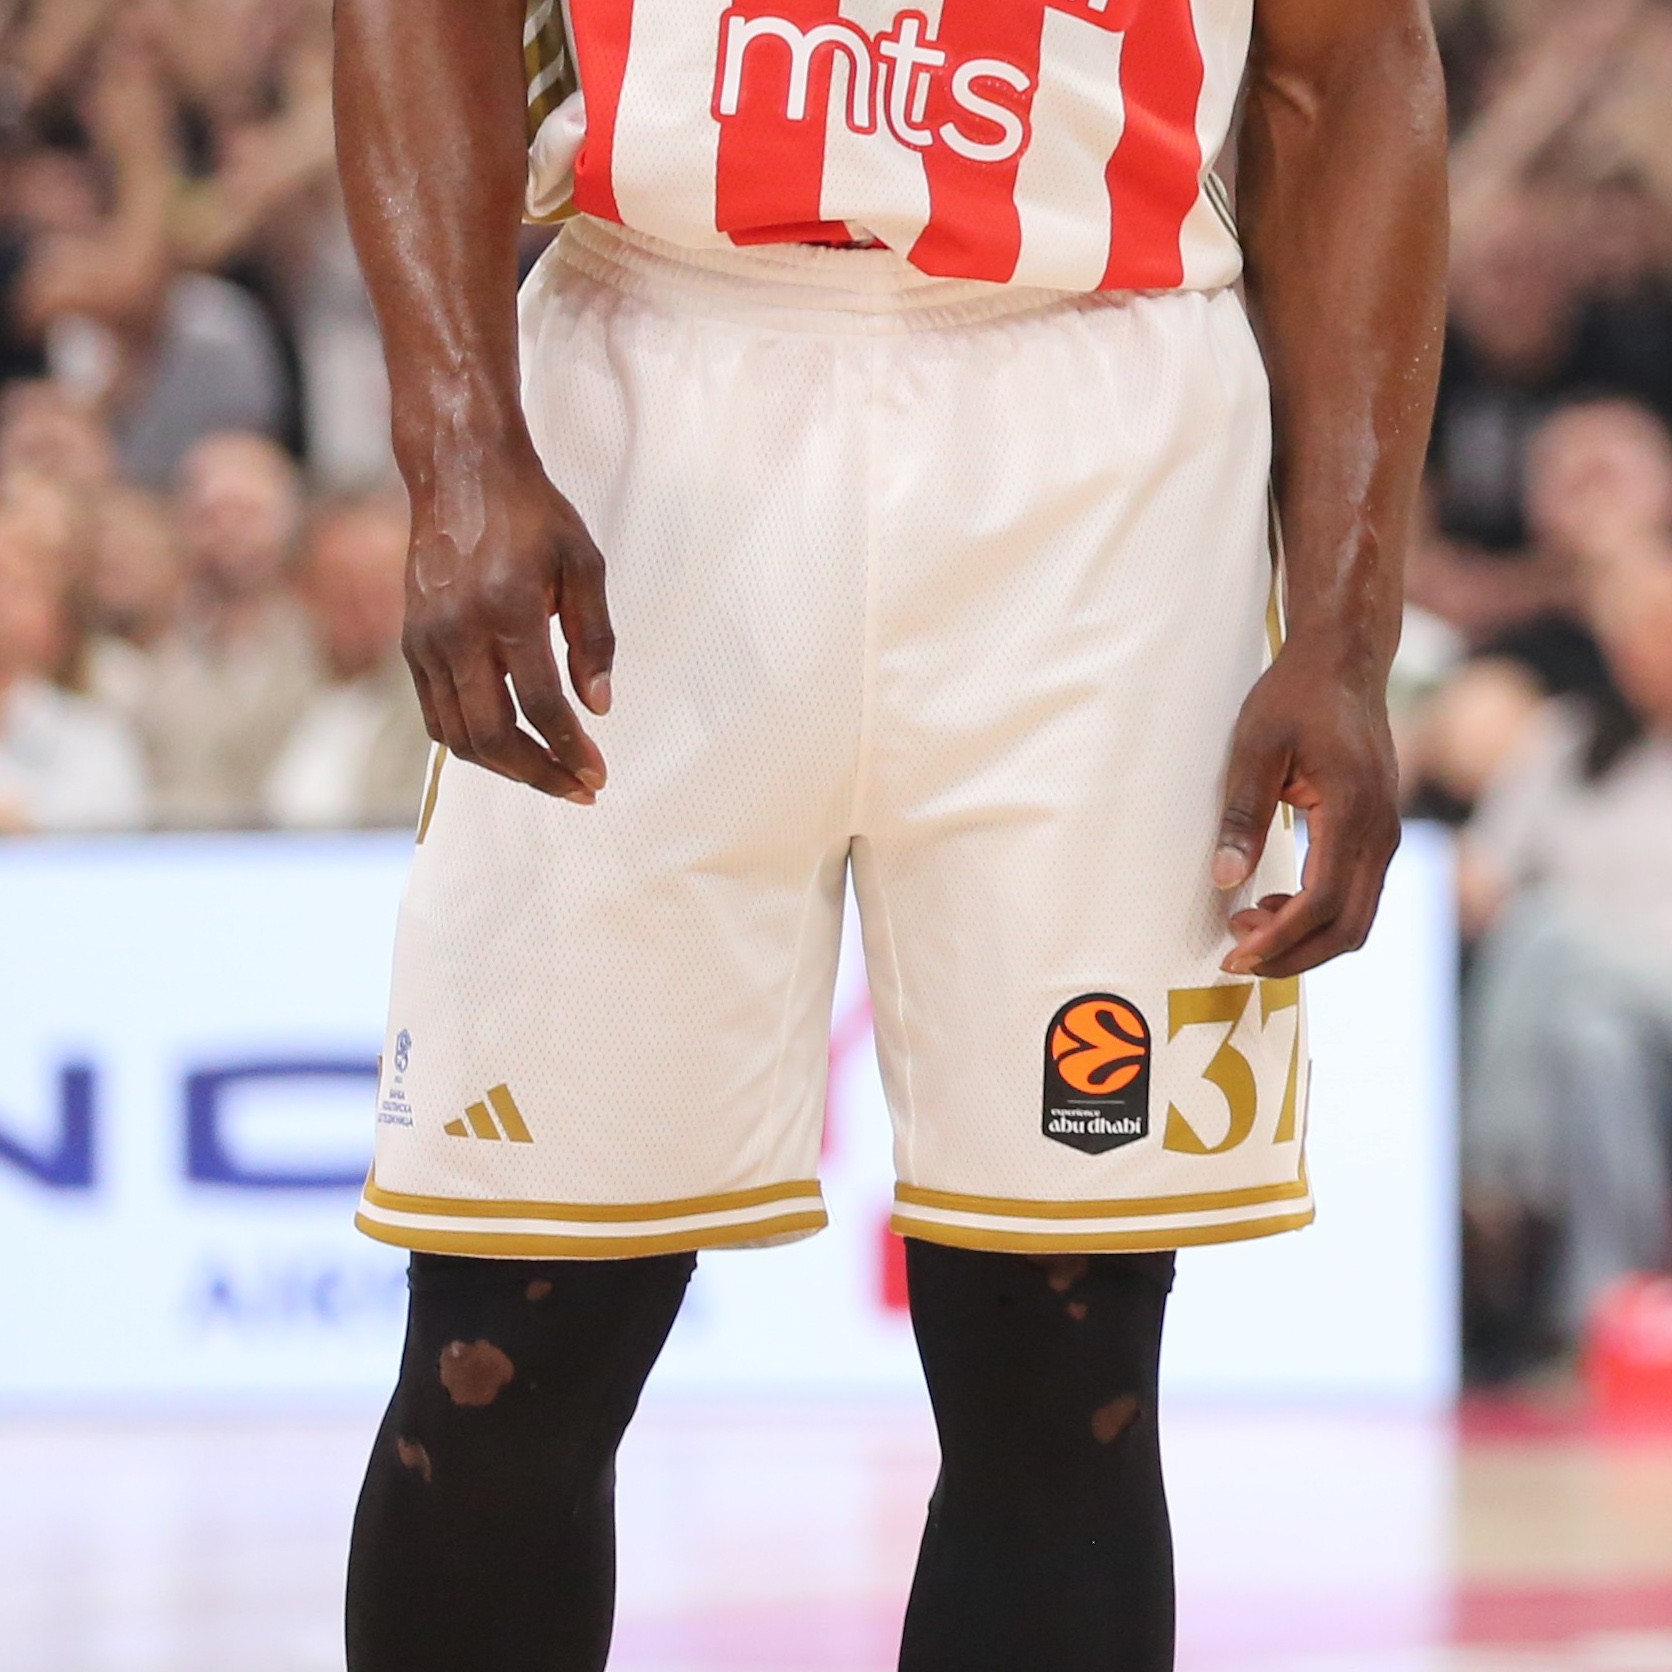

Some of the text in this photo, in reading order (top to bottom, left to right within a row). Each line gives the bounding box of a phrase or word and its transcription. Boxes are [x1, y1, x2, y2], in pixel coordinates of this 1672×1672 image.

[716, 9, 1034, 163] mts
[1048, 1116, 1142, 1134] abu dhabi
